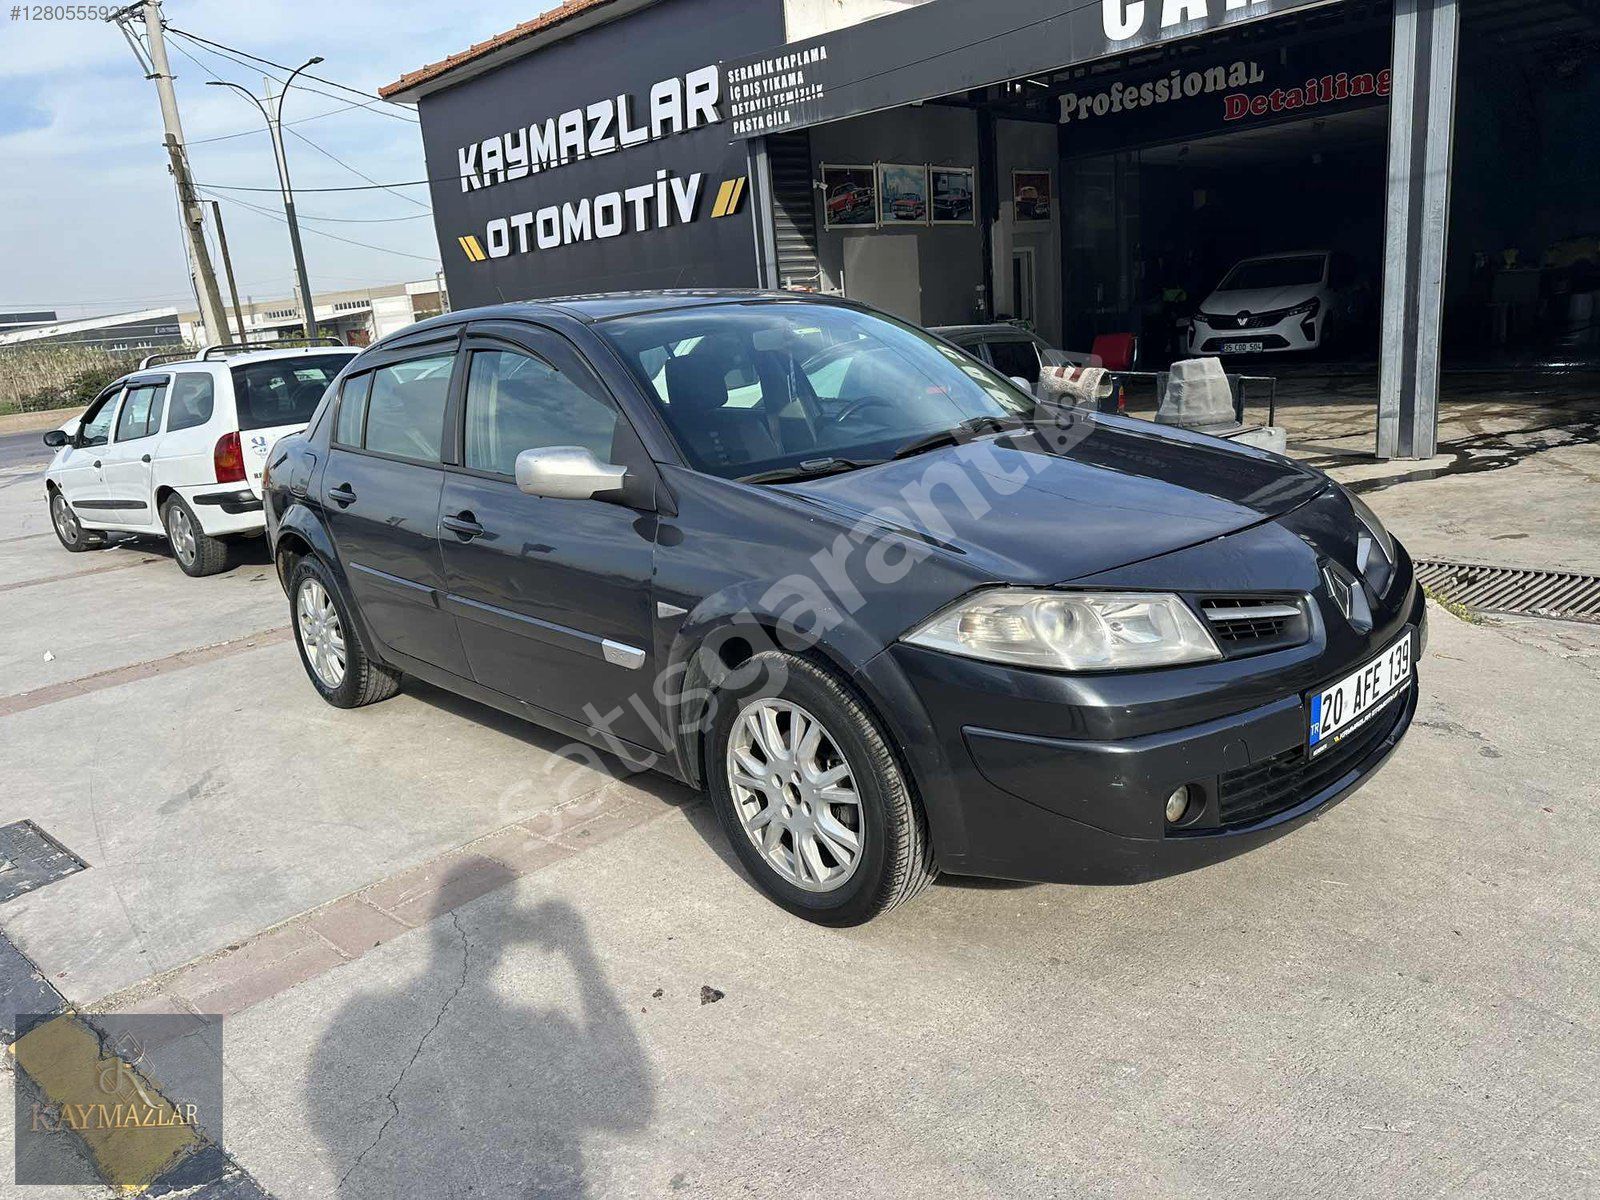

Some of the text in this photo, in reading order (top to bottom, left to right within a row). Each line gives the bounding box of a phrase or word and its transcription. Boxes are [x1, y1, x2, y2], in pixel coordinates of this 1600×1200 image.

[727, 45, 827, 84] SERAMİK KAPLAMA
[762, 70, 804, 93] YIKAMA
[1223, 69, 1392, 121] Detailing
[458, 64, 722, 194] KAYMAZLAR
[732, 109, 791, 135] PASTA CİLA
[486, 168, 701, 259] OTOMOTİV
[1310, 722, 1320, 736] TR
[1321, 687, 1344, 735] 20
[1353, 661, 1382, 714] AFE
[1388, 639, 1410, 687] 139
